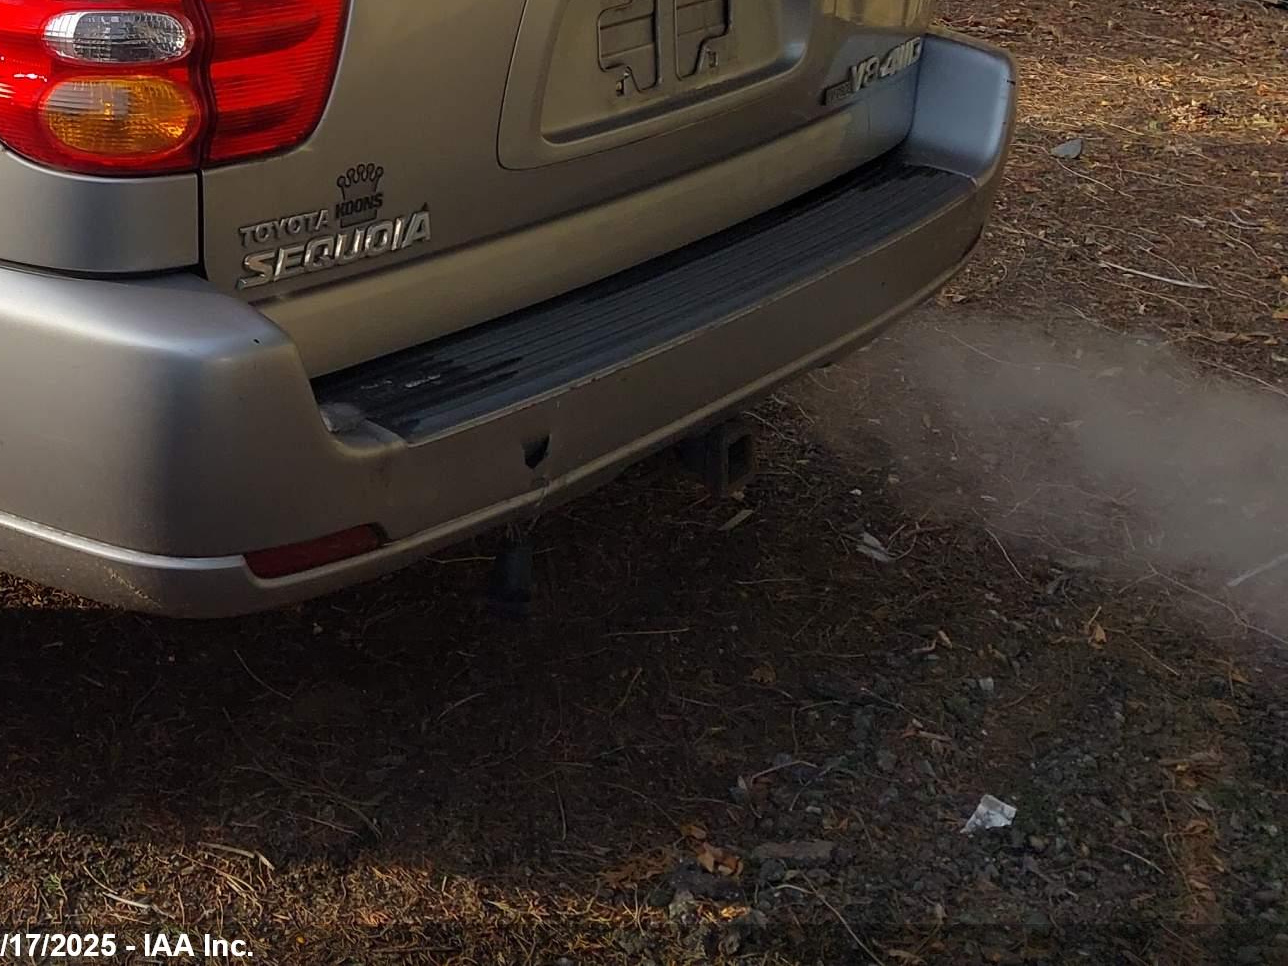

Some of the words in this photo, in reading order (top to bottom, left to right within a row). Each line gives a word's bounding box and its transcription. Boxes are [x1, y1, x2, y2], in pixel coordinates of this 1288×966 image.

[335, 193, 384, 220] KOONS
[239, 209, 328, 248] TOYOTA
[236, 208, 431, 290] SEQUOIA
